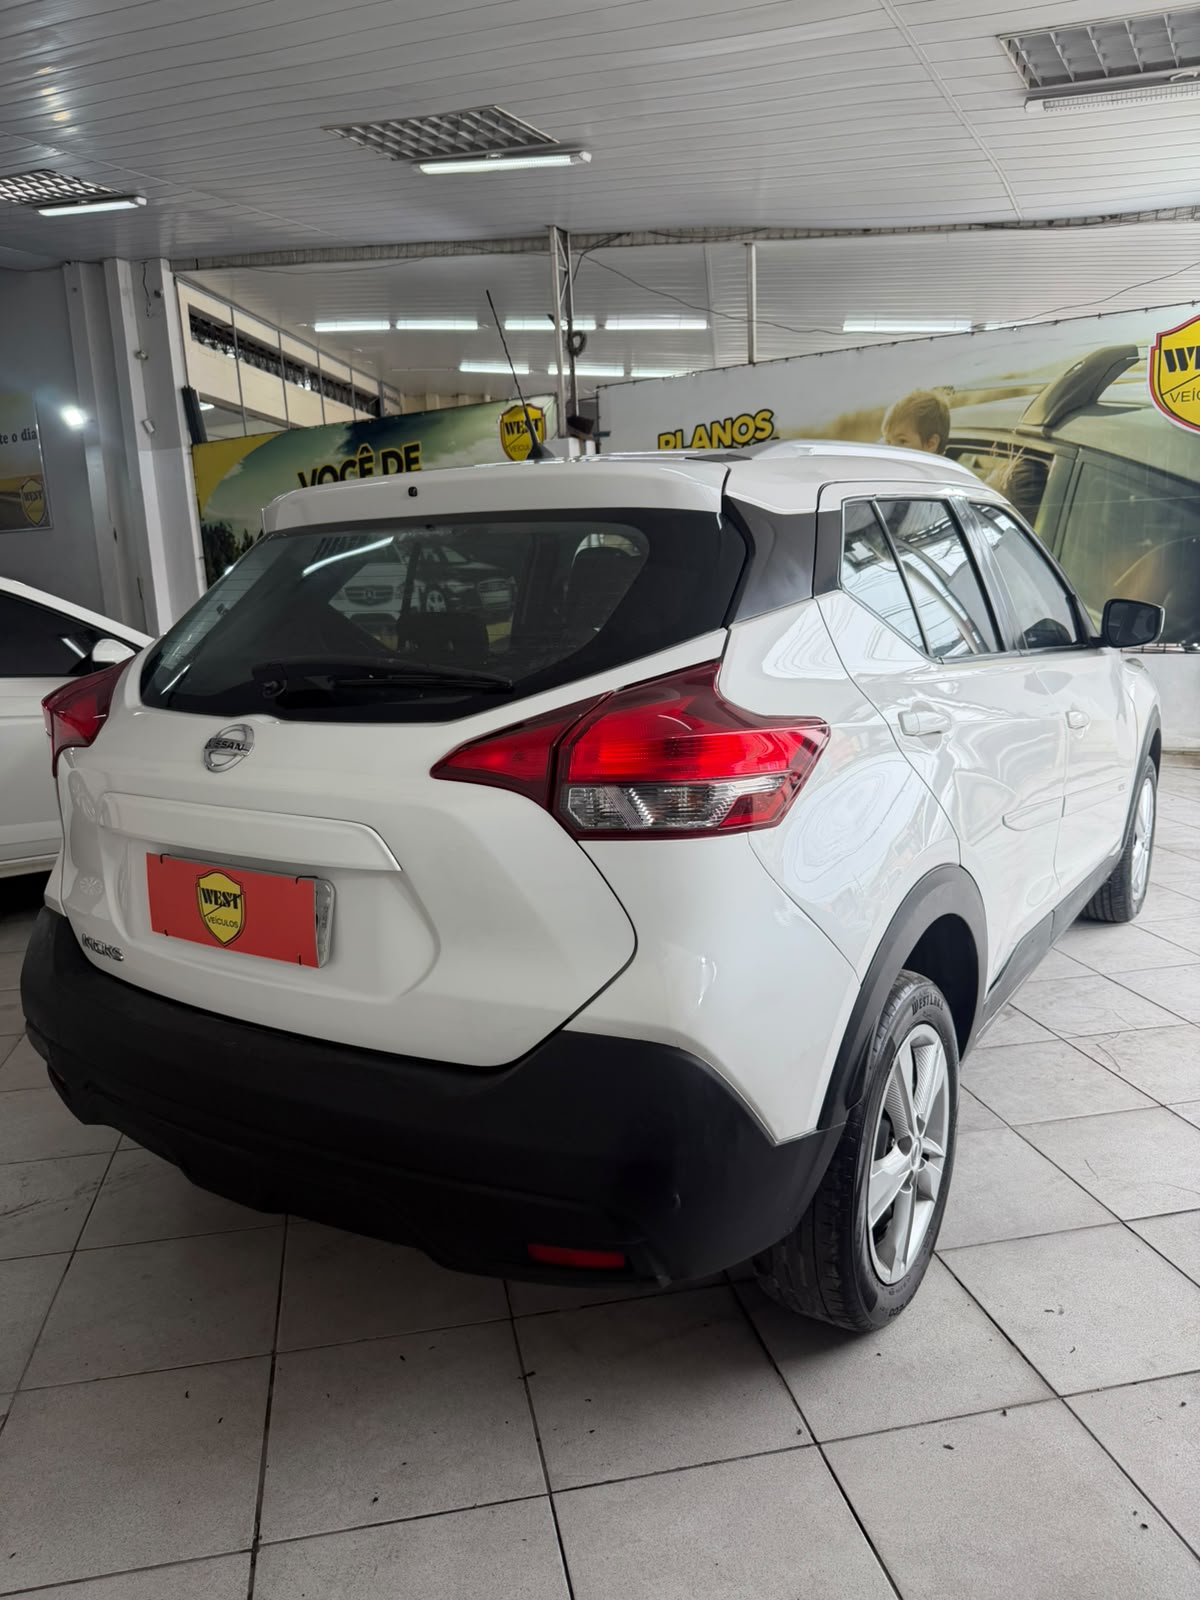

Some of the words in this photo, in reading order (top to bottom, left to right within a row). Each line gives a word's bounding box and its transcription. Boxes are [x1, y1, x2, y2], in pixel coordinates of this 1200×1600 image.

[11, 432, 18, 443] o
[21, 427, 38, 441] dia
[505, 418, 542, 435] WET
[658, 408, 774, 449] PLANOS
[297, 443, 375, 488] VOCÊ
[380, 441, 421, 475] DE
[201, 887, 241, 909] WEST
[207, 915, 239, 929] VEÍCULOS
[82, 933, 124, 962] KICKS
